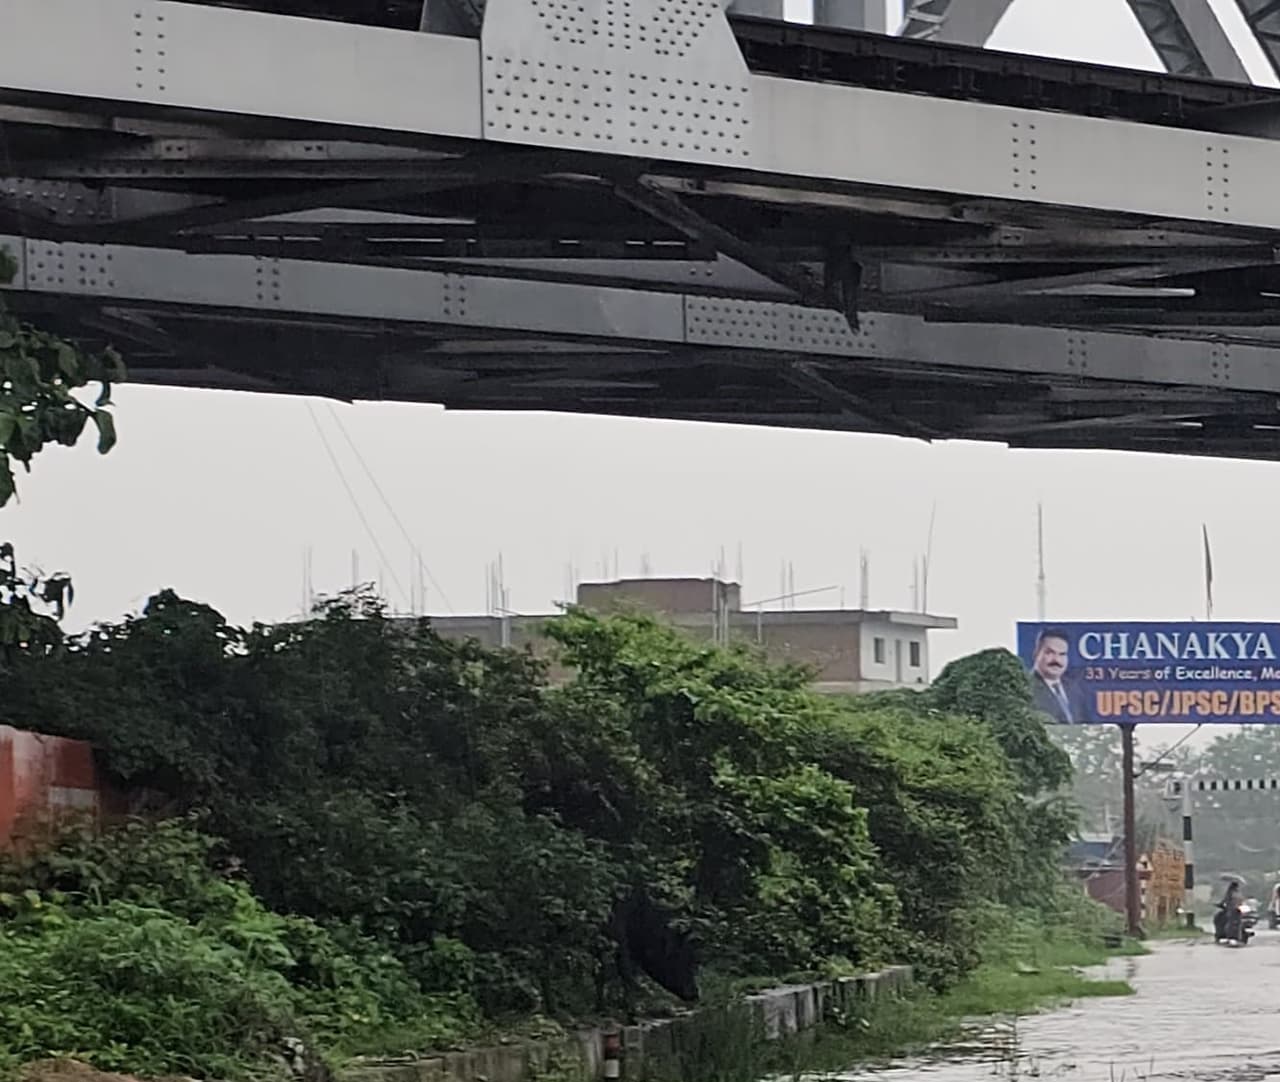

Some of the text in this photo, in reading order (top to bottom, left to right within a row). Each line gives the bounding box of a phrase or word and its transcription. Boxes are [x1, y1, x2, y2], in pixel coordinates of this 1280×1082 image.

[1078, 632, 1276, 660] CHANAKYA
[1085, 667, 1105, 680] 33
[1108, 667, 1151, 680] Years
[1154, 666, 1170, 680] of
